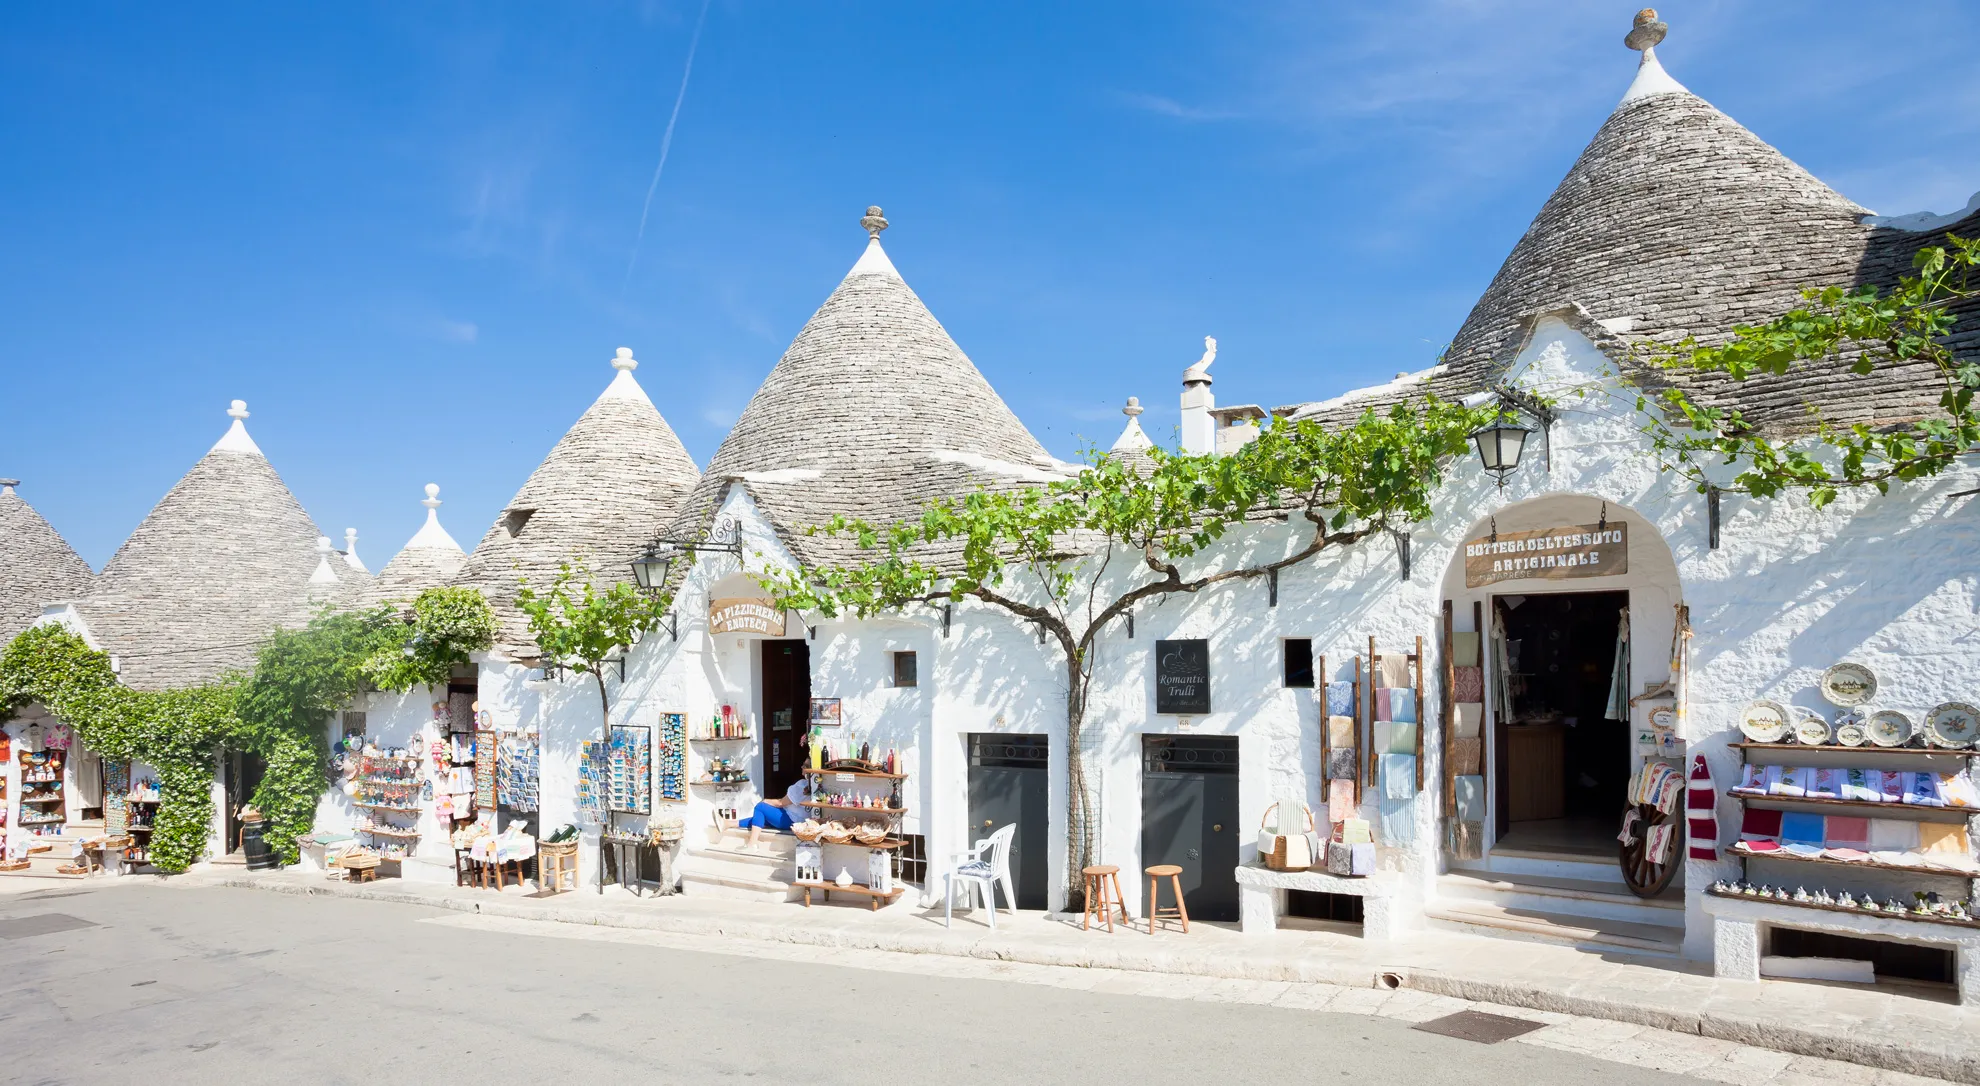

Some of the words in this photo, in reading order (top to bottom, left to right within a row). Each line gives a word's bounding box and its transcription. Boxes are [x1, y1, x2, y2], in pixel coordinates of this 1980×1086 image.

[1466, 541, 1525, 557] BOTTEGA
[1493, 551, 1599, 572] ARTIGIANALE
[711, 611, 724, 626] LA
[724, 604, 783, 626] PIZZICHERIA
[726, 616, 768, 632] ENOTECA
[1159, 673, 1205, 686] Romantic
[1167, 684, 1196, 696] Trulli
